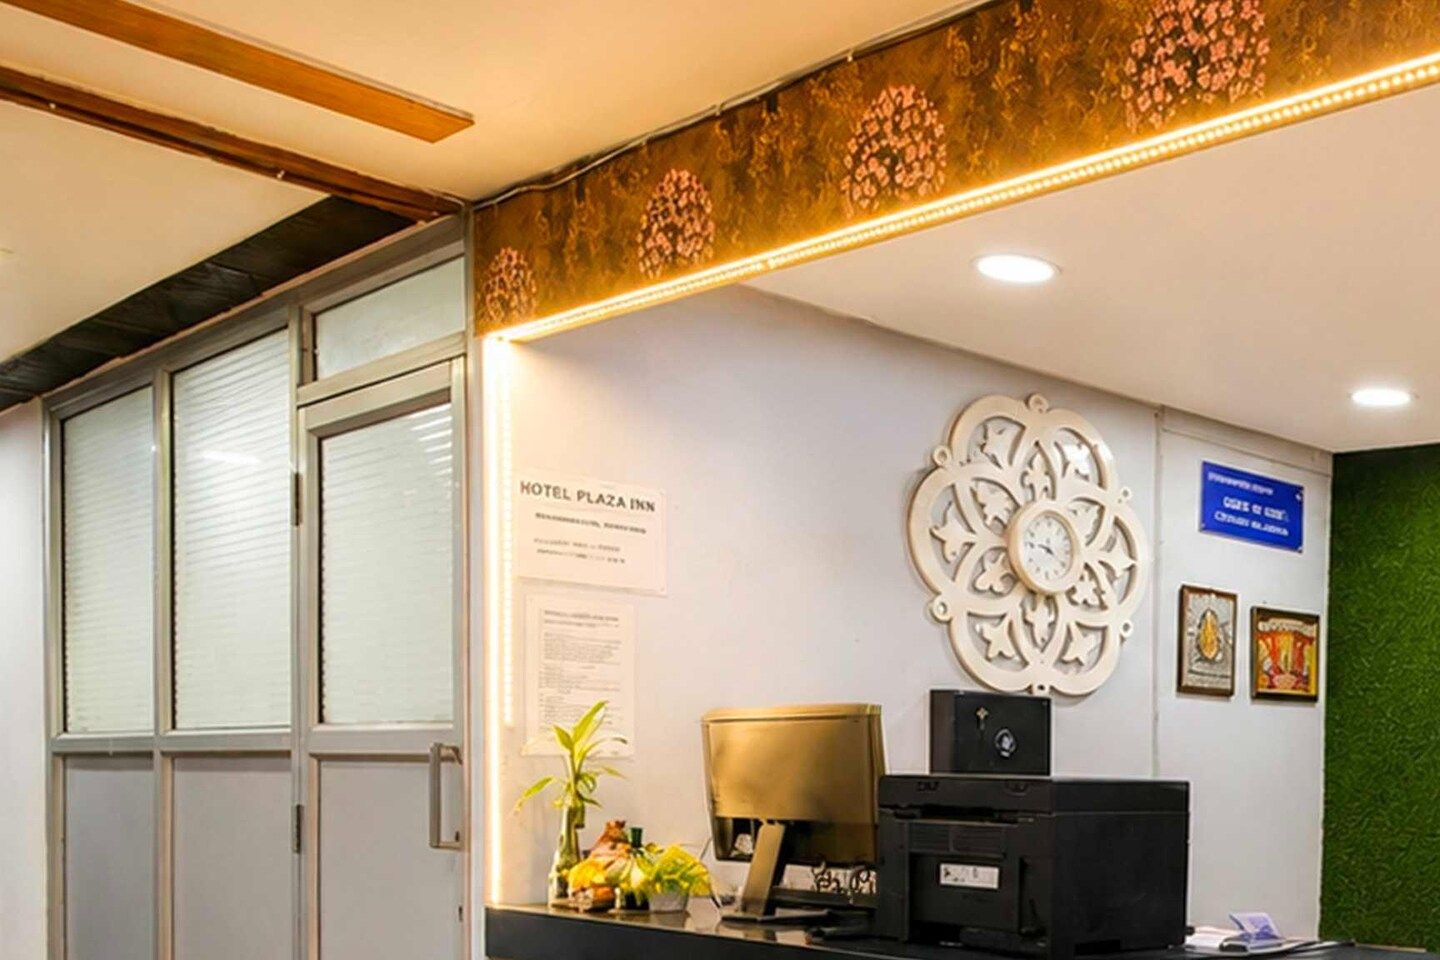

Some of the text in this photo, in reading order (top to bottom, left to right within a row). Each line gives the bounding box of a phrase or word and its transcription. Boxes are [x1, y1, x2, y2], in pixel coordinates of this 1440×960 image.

[520, 480, 656, 512] HOTEL PLAZA INN
